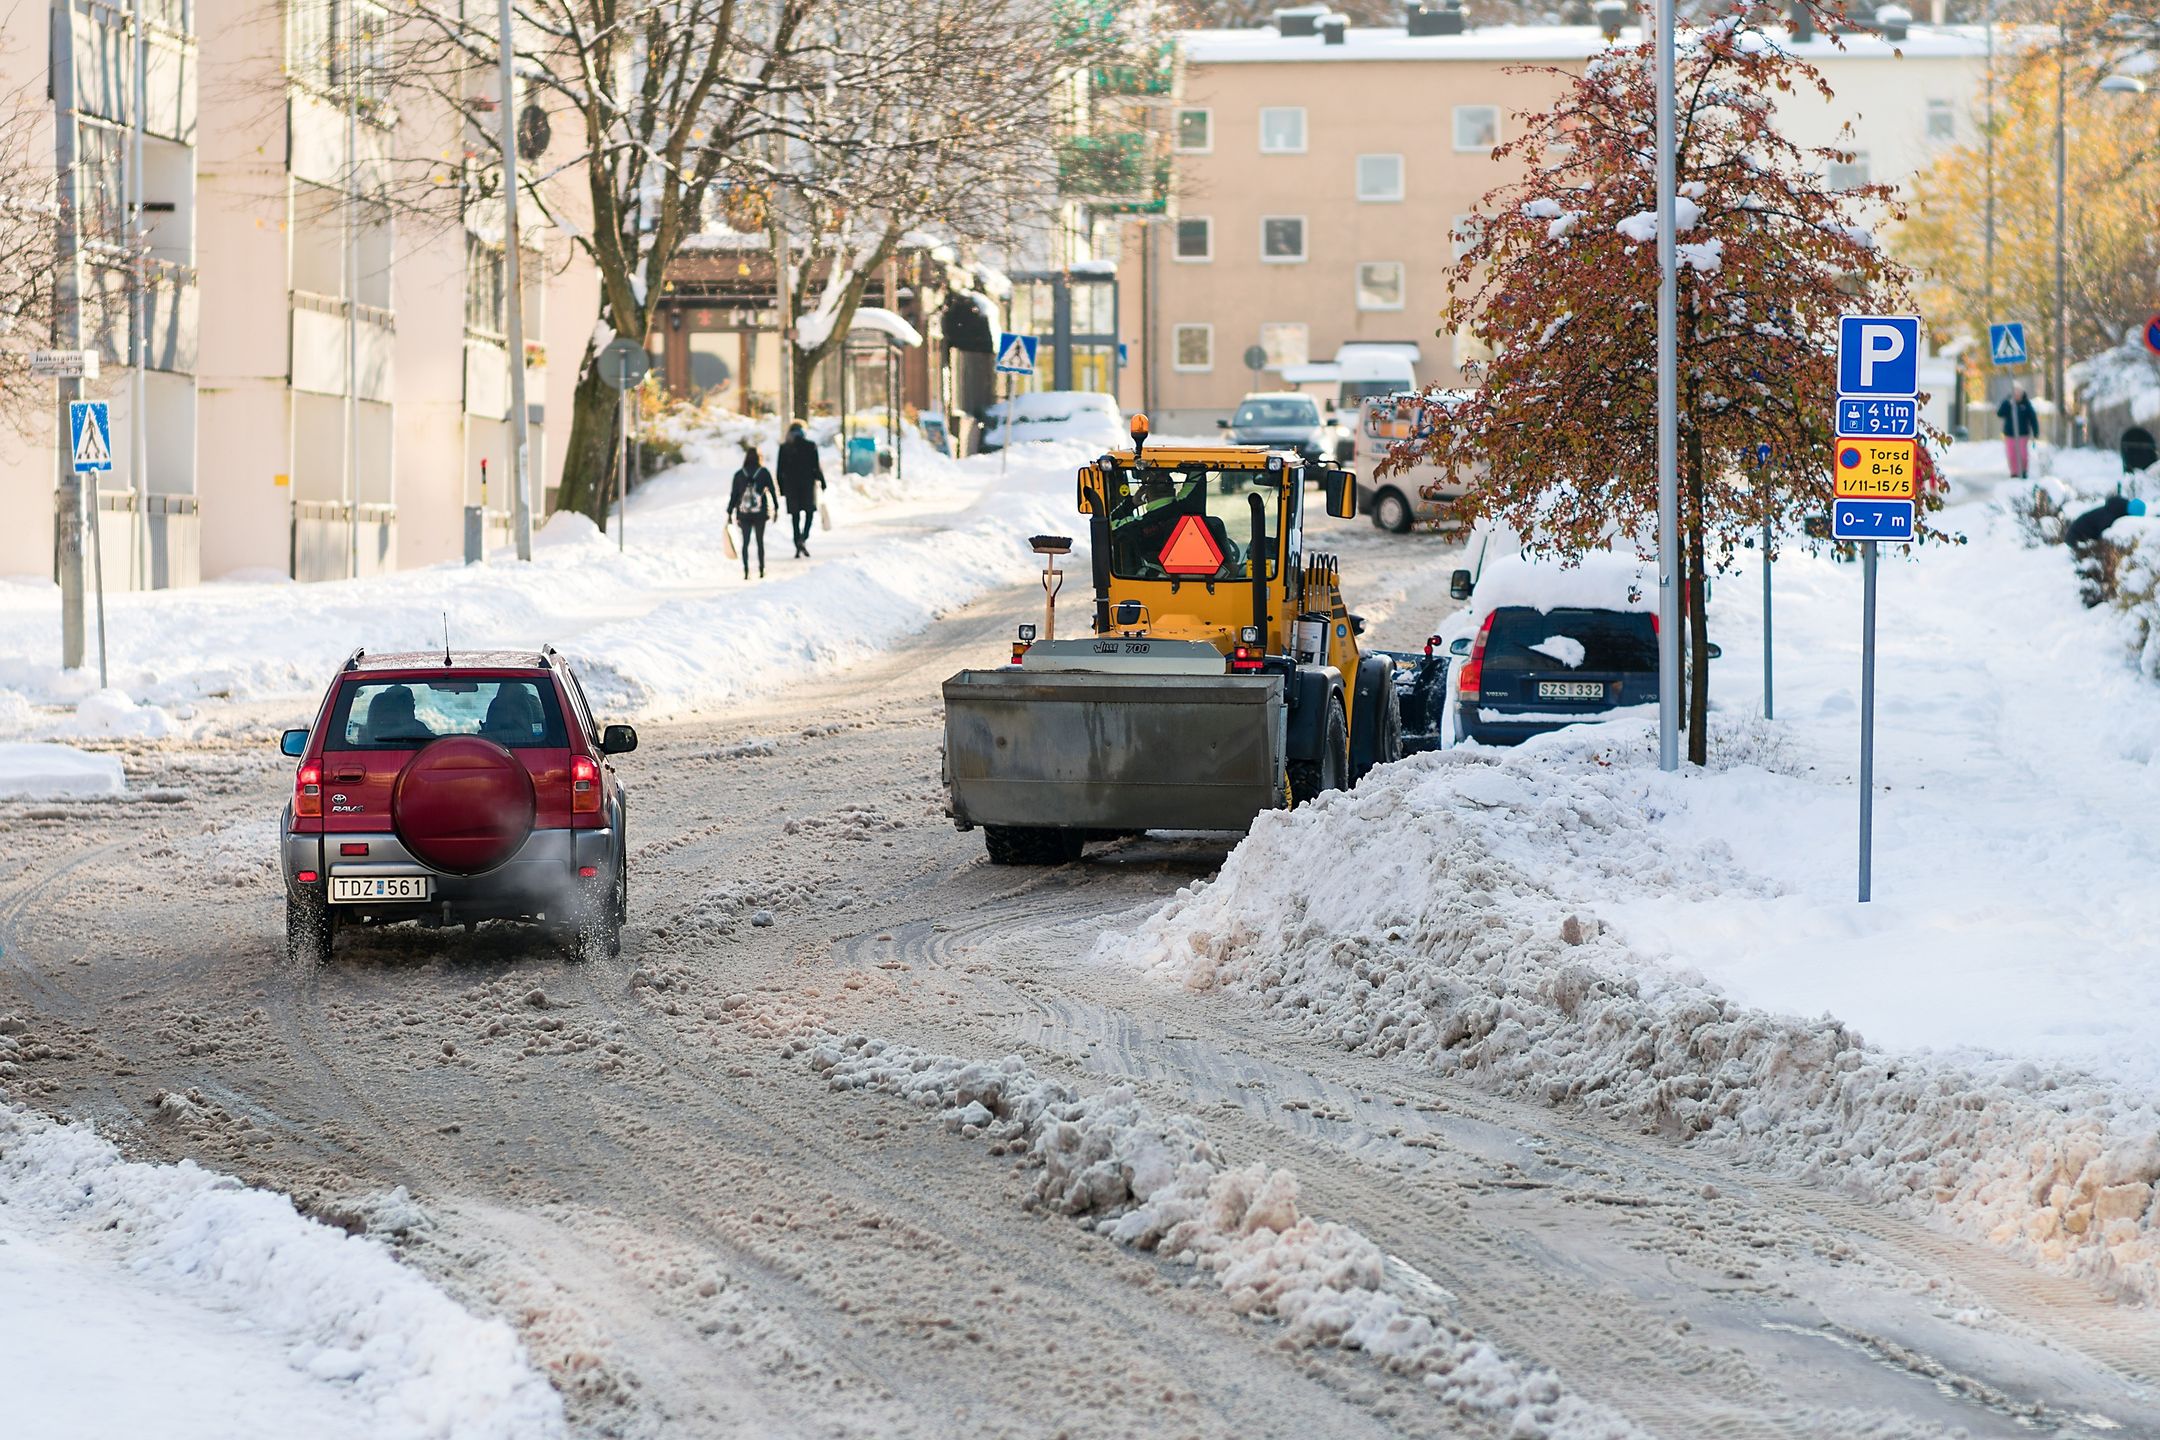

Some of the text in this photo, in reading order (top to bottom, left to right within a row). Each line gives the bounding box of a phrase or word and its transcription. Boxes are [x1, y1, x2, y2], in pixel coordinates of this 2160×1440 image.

[1860, 324, 1905, 387] P
[1868, 403, 1909, 417] 4 tim
[1870, 418, 1908, 432] 9-17
[1870, 449, 1909, 460] Torsd
[1872, 464, 1903, 475] 8-16
[1843, 480, 1909, 492] 1/11-15/5
[1872, 513, 1883, 527] 7
[1891, 516, 1904, 527] m
[1126, 643, 1150, 654] 700
[1541, 683, 1602, 696] SZS 332
[338, 880, 420, 896] TDZ 561
